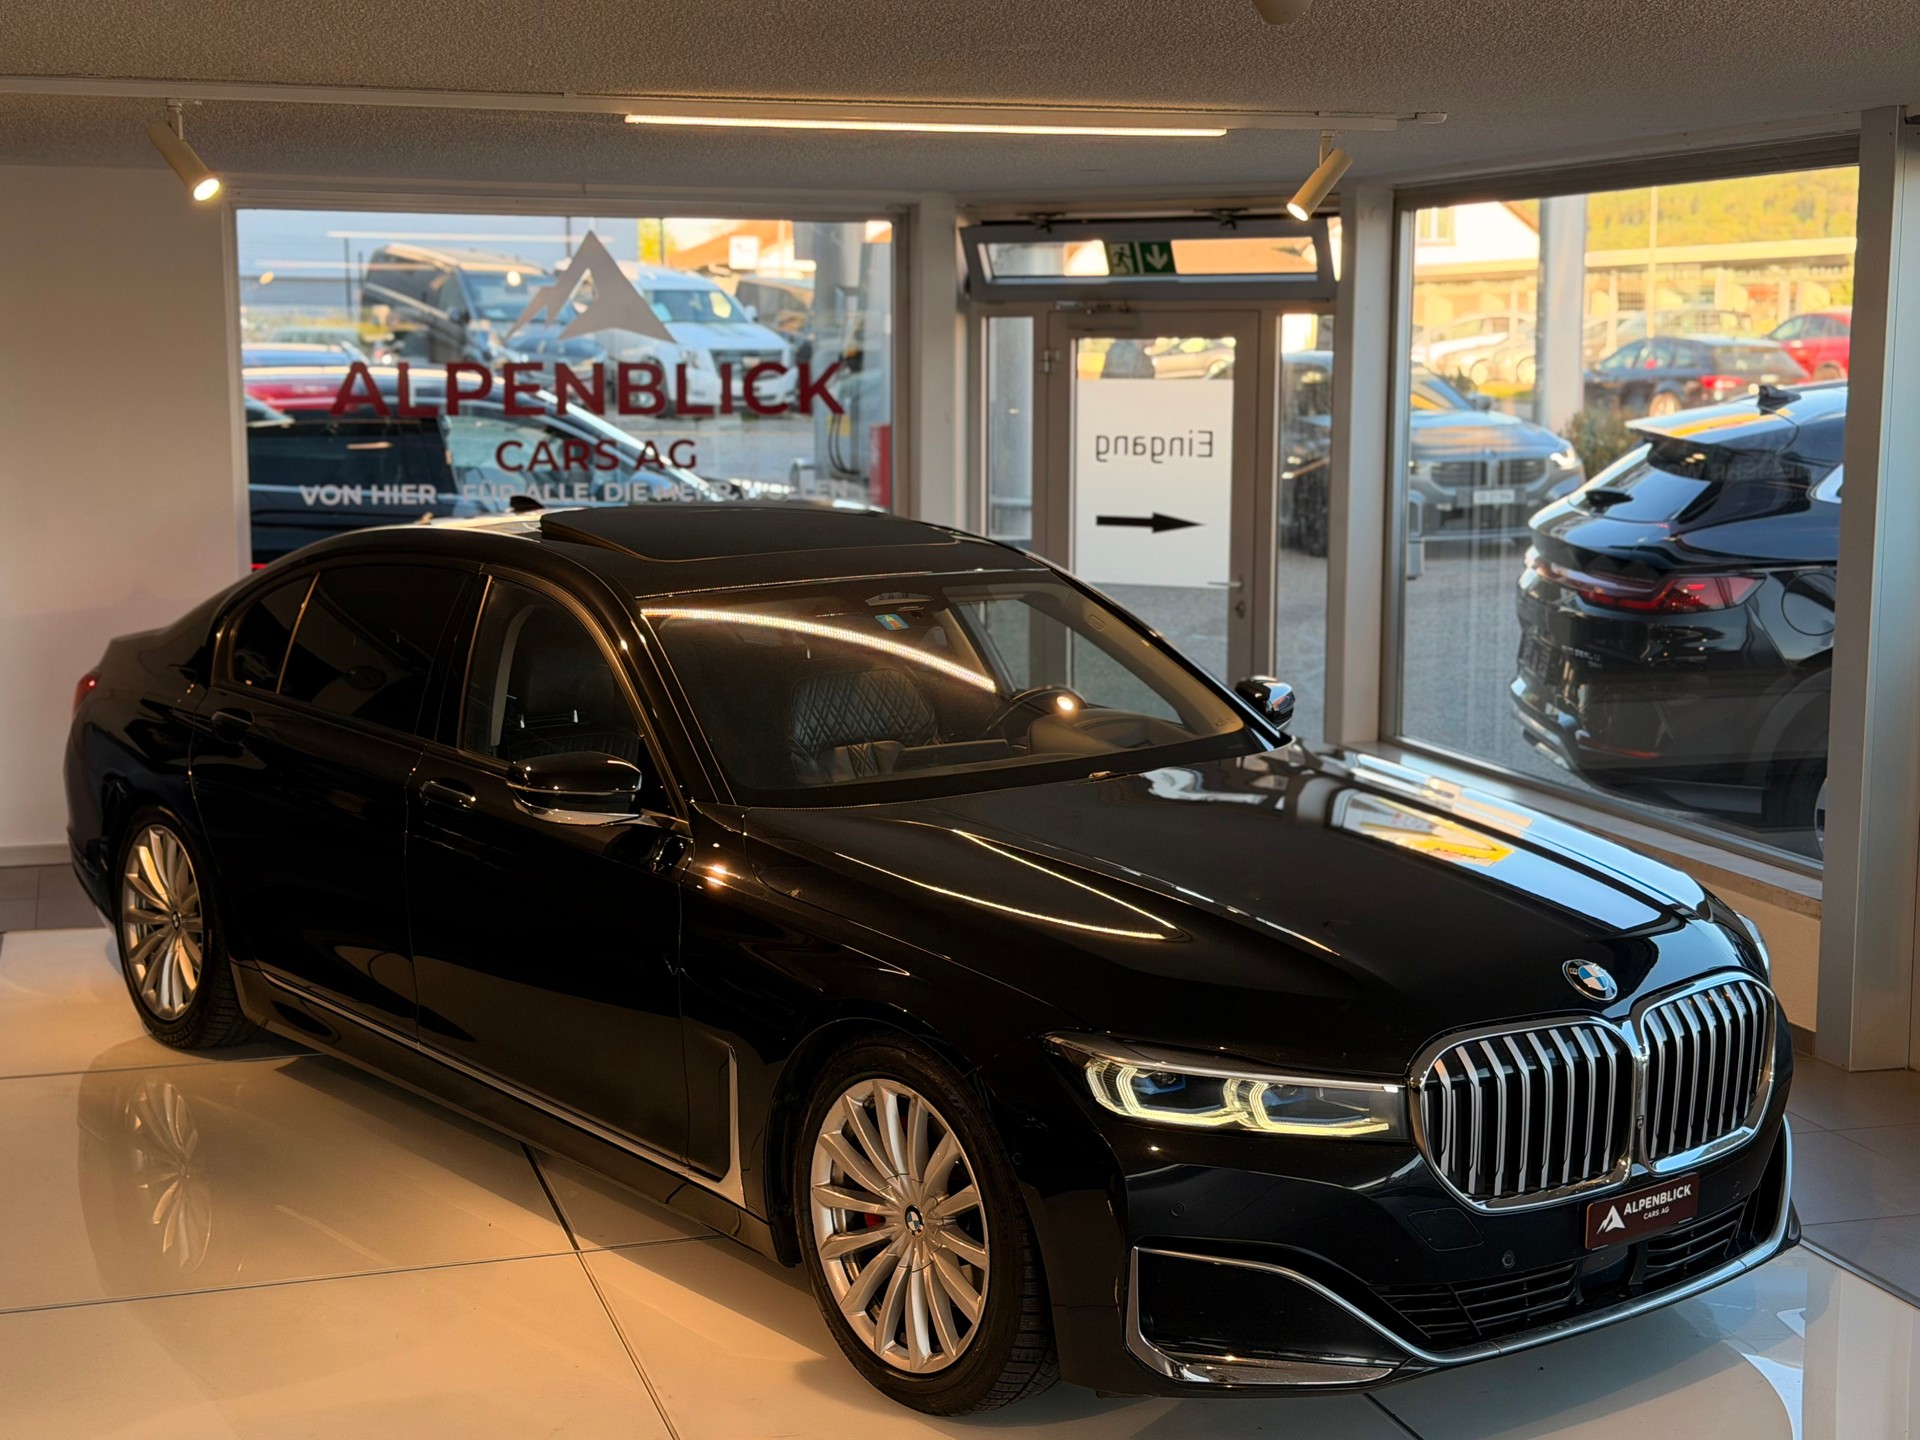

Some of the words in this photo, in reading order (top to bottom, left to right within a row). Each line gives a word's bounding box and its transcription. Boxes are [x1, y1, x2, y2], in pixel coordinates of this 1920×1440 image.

[330, 362, 845, 416] ALPENBLICK
[495, 439, 619, 473] CARS
[634, 439, 697, 471] AG
[300, 484, 361, 506] VON
[371, 484, 437, 505] HIER
[462, 480, 516, 503] FÜR
[604, 482, 648, 501] DIE
[1623, 1184, 1691, 1215] ALPENBLICK
[1643, 1209, 1659, 1220] CARS
[1661, 1206, 1670, 1214] AG
